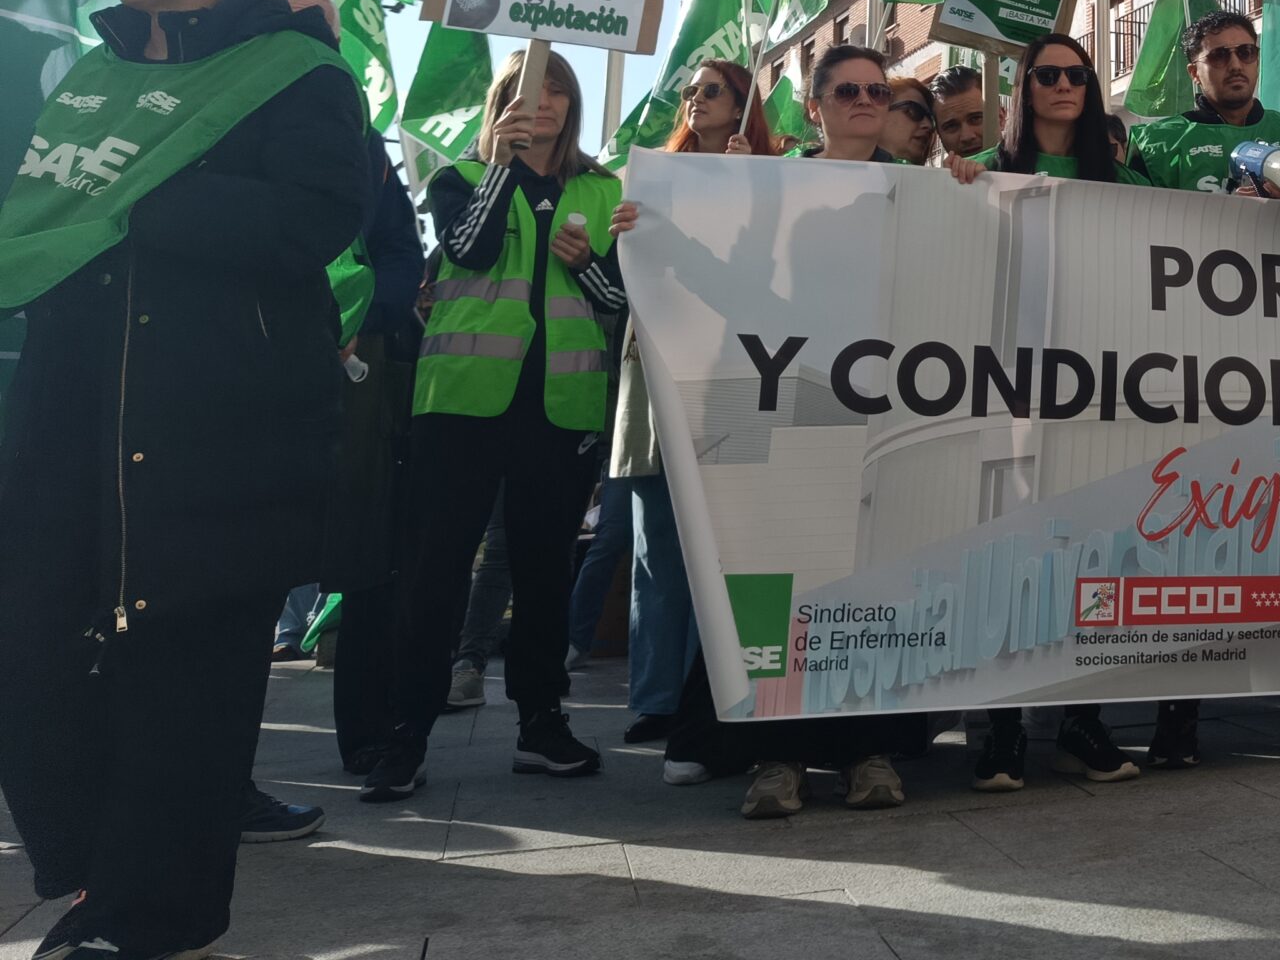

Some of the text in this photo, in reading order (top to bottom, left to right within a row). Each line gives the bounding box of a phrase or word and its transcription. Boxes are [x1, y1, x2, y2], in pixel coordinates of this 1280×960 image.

[509, 0, 629, 36] explotación
[949, 6, 975, 20] SATSE
[1189, 144, 1223, 156] SATSE
[737, 333, 809, 412] Y
[1132, 585, 1242, 615] CCOO
[797, 603, 897, 624] Sindicato
[794, 626, 947, 652] de Enfermería
[1075, 630, 1148, 645] federación
[1152, 630, 1168, 643] de
[1172, 628, 1223, 642] sanidad
[1226, 631, 1235, 644] y
[793, 655, 849, 672] Madrid
[1075, 647, 1246, 666] sociosanitarios de Madrid
